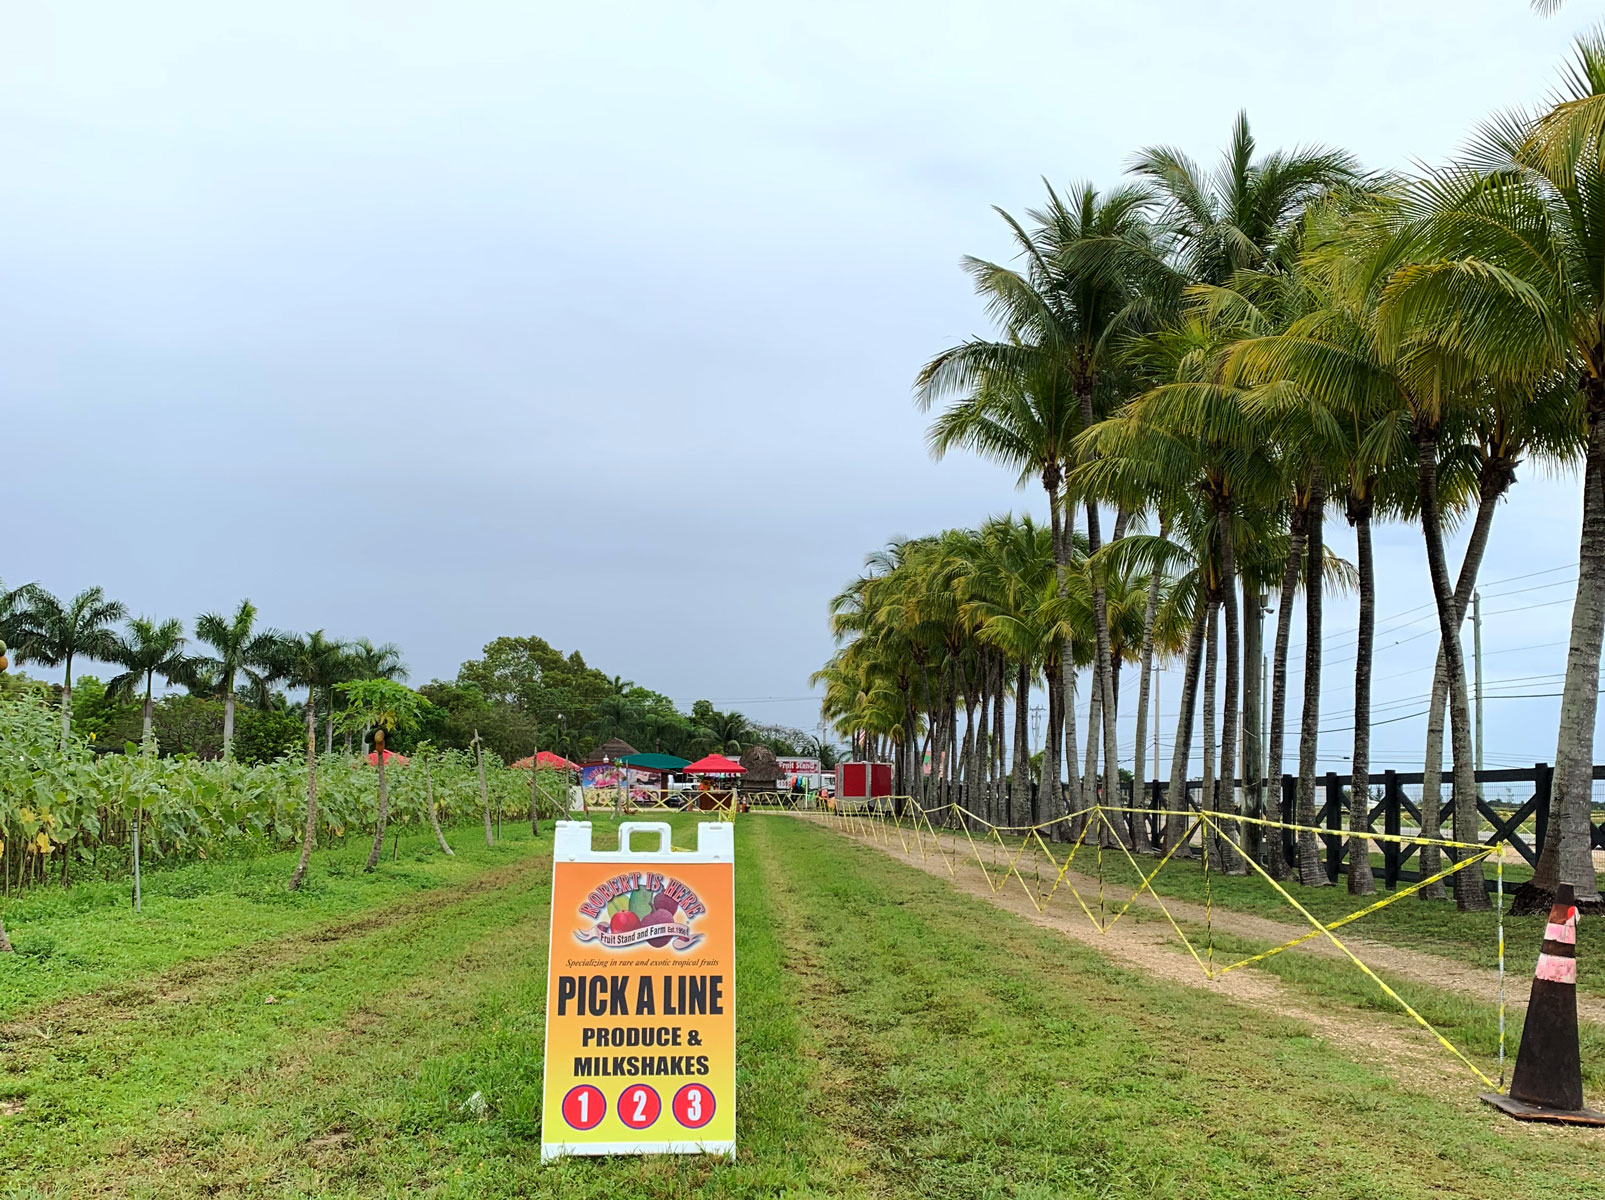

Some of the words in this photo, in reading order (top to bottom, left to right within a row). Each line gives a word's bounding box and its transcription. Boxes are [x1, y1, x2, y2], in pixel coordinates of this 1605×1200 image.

[580, 872, 640, 918] ROBERT
[645, 872, 663, 891] IS
[663, 878, 705, 918] HERE
[600, 933, 616, 944] Fruit
[617, 932, 635, 944] Stand
[636, 929, 648, 939] and
[650, 926, 666, 936] Farm
[566, 959, 608, 968] Specializing
[672, 958, 699, 968] tropical
[697, 958, 719, 968] fruits
[557, 975, 630, 1017] PICK
[635, 975, 656, 1016] A
[663, 975, 724, 1016] LINE
[582, 1027, 682, 1047] PRODUCE
[687, 1029, 703, 1046] &
[573, 1056, 710, 1077] MILKSHAKES
[577, 1091, 589, 1122] 1
[632, 1090, 647, 1122] 2
[687, 1089, 702, 1121] 3
